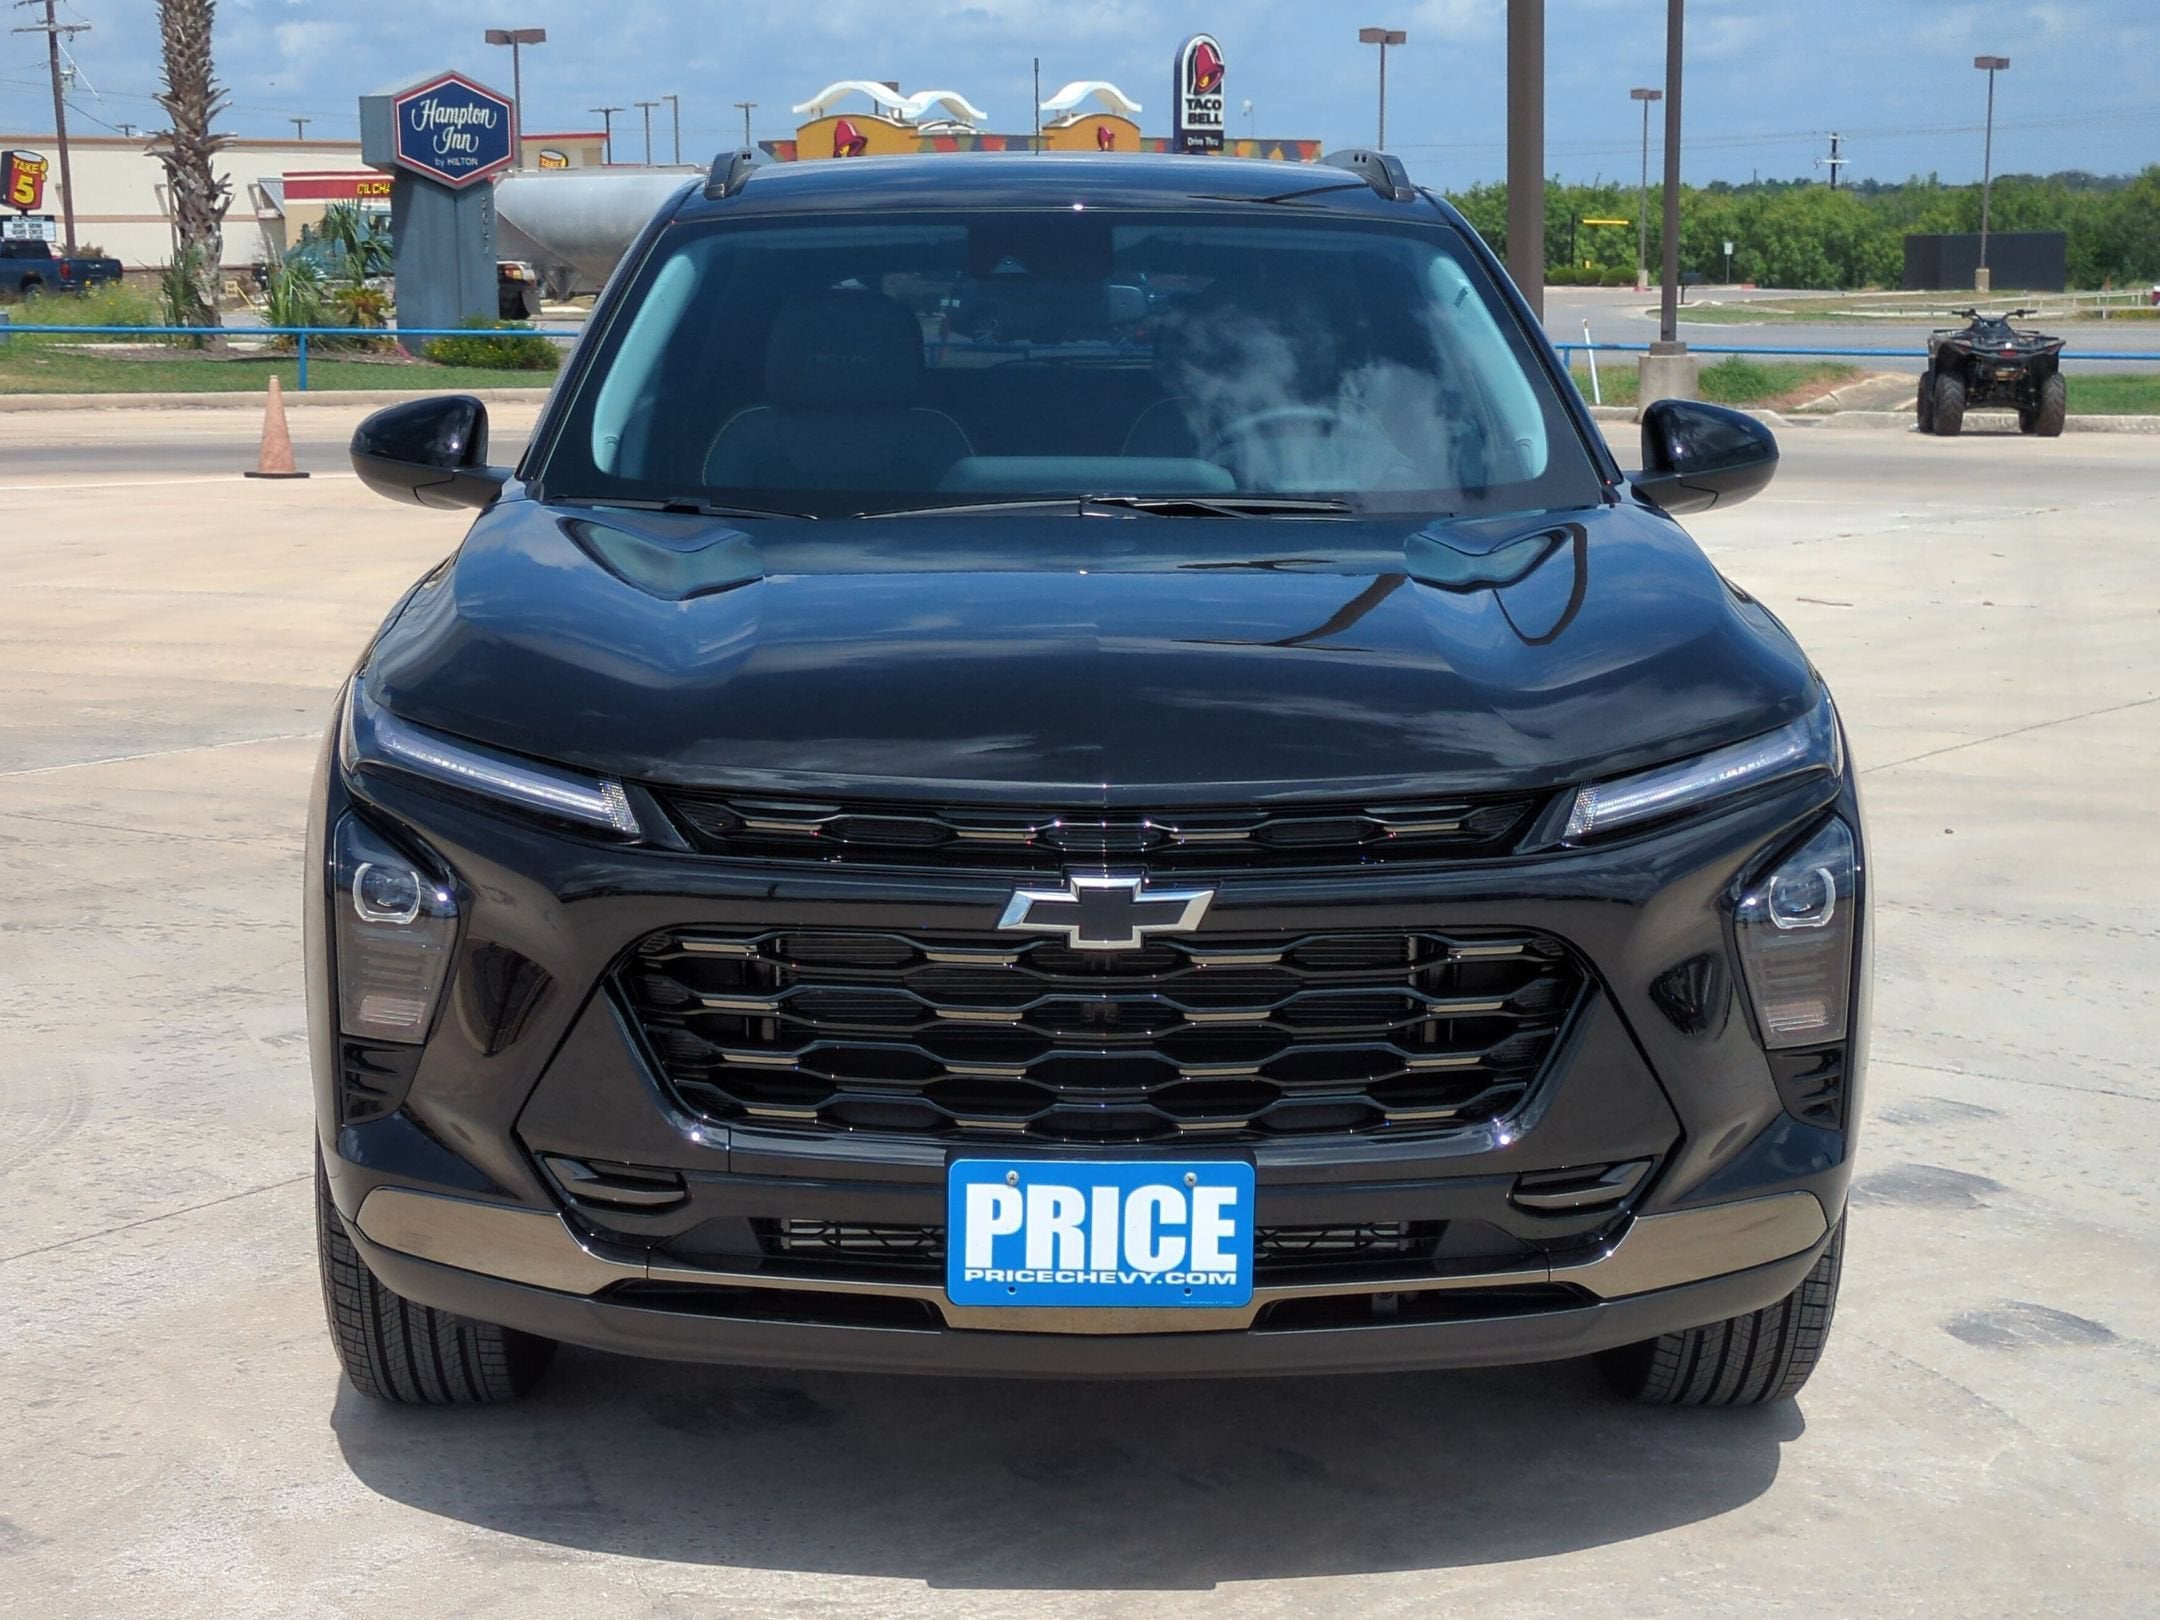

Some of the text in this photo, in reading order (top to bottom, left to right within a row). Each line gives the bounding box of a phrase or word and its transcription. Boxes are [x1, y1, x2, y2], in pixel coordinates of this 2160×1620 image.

[1185, 99, 1222, 110] TACO
[411, 99, 496, 131] Hampton
[1187, 113, 1222, 124] BELL
[433, 127, 479, 154] Inn
[1187, 136, 1219, 146] Drive Thru
[13, 158, 41, 173] TAKE
[434, 157, 479, 168] by HILTON
[13, 175, 34, 204] 5
[965, 1183, 1238, 1272] PRICE
[964, 1268, 1237, 1285] PRICECHEVY.COM
